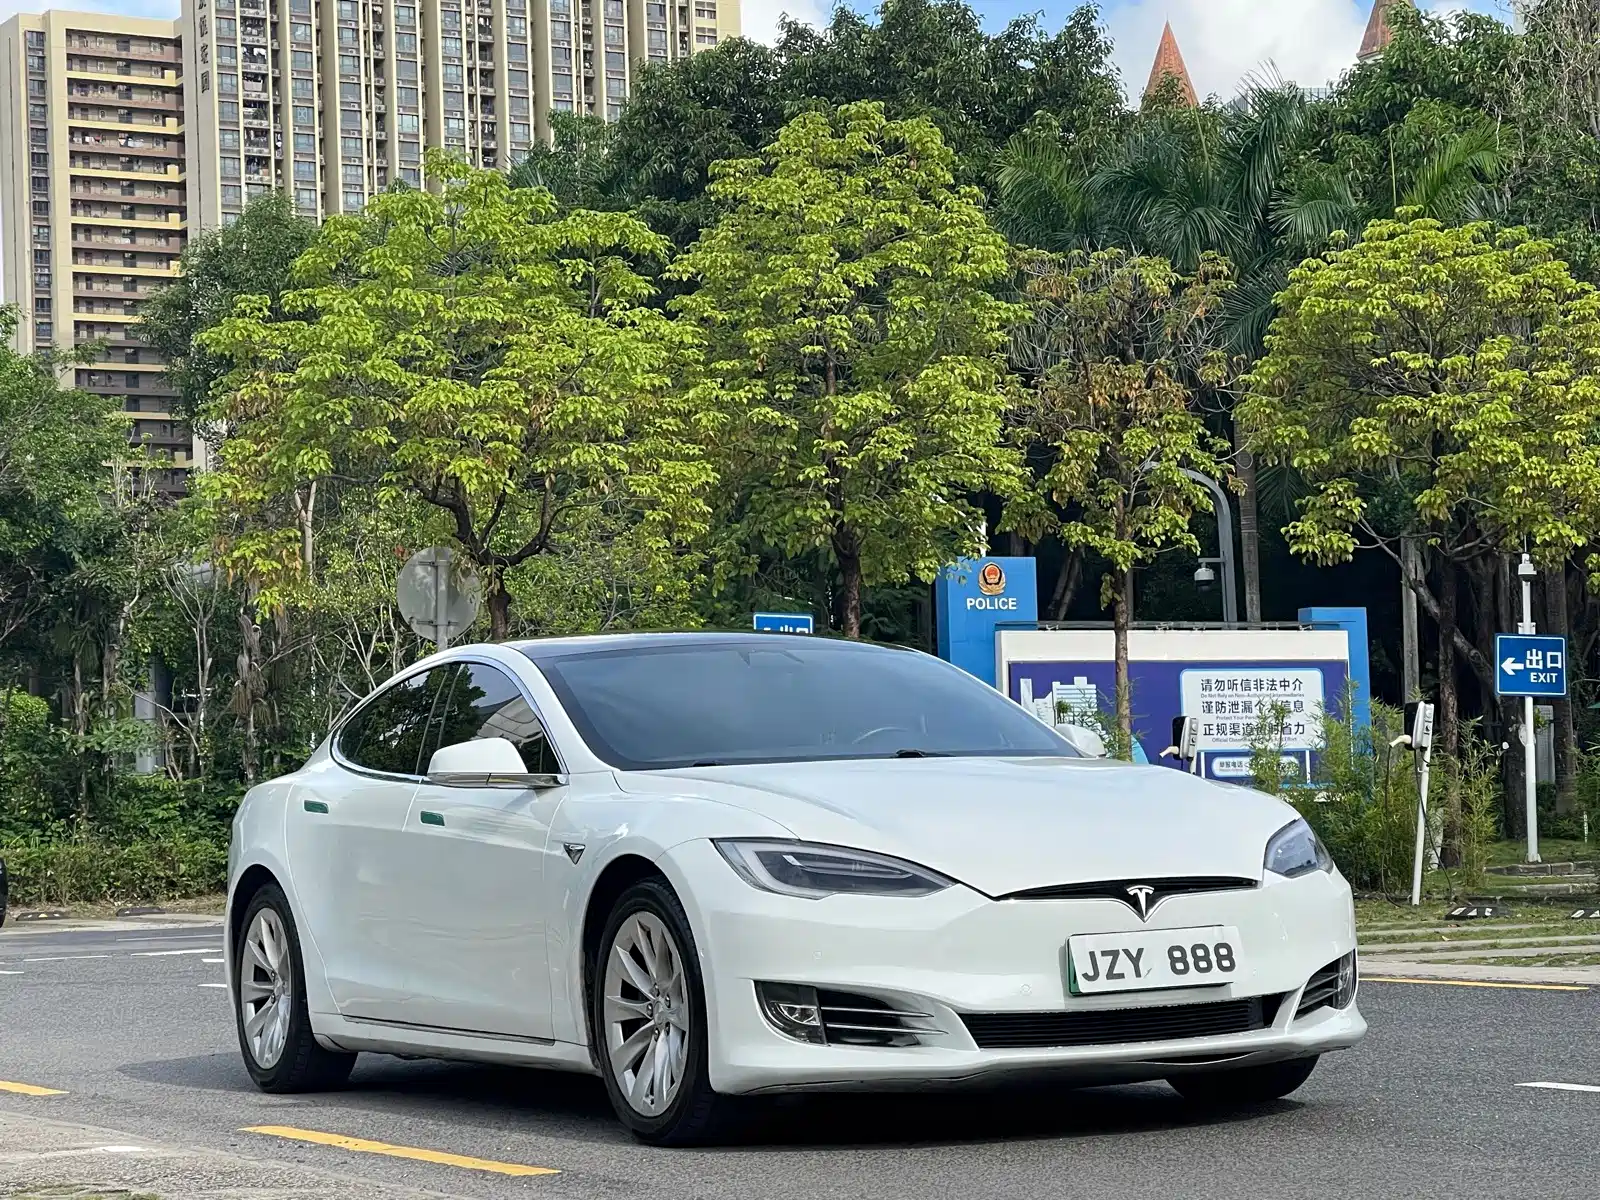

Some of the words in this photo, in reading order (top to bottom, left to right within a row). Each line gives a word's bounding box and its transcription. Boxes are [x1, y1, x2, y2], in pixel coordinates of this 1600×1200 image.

[966, 597, 1017, 610] POLICE
[1526, 648, 1562, 669] 出口
[1530, 672, 1558, 683] EXIT
[1200, 678, 1304, 692] 请勿听信非法中介
[1082, 947, 1144, 982] JZY
[1167, 942, 1236, 976] 888
